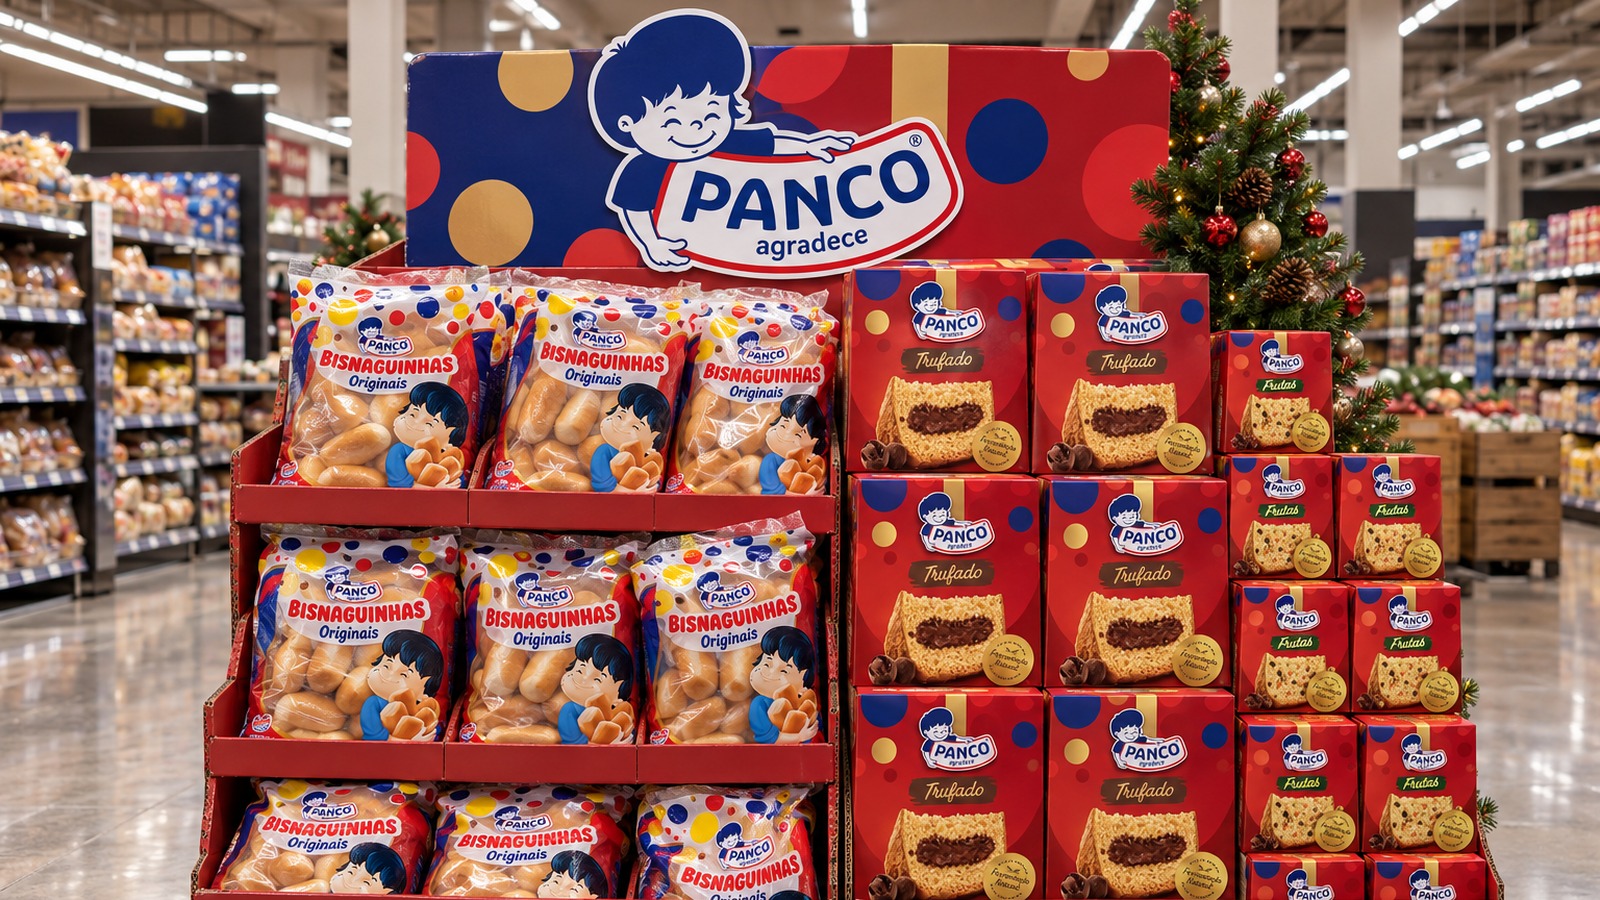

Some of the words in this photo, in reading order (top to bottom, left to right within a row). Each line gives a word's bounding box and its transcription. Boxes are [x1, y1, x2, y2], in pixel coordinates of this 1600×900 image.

[681, 149, 931, 231] PANCO
[756, 229, 868, 261] agradece
[925, 315, 979, 331] PANCO
[1110, 319, 1160, 334] PANCO
[367, 339, 408, 351] PANCO
[582, 332, 621, 345] PANCO
[319, 350, 454, 375] BISNAGUINHAS
[540, 341, 665, 372] BISNAGUINHAS
[746, 349, 785, 361] PANCO
[916, 351, 973, 371] Trufado
[1101, 353, 1156, 373] Trufado
[1269, 358, 1300, 368] PANCO
[565, 367, 622, 387] Originais
[703, 363, 821, 384] BISNAGUINHAS
[348, 375, 407, 392] Originais
[1262, 379, 1297, 391] Frutas
[729, 385, 783, 403] Originais
[1271, 482, 1302, 492] PANCO
[1381, 482, 1412, 492] PANCO
[933, 526, 988, 543] PANCO
[1123, 527, 1177, 545] PANCO
[924, 564, 983, 585] Trufado
[1113, 565, 1171, 586] Trufado
[335, 585, 376, 597] PANCO
[527, 590, 568, 603] PANCO
[711, 587, 750, 604] PANCO
[288, 599, 426, 623] BISNAGUINHAS
[485, 603, 617, 629] BISNAGUINHAS
[669, 594, 798, 633] BISNAGUINHAS
[1284, 614, 1316, 625] PANCO
[1397, 614, 1429, 625] PANCO
[319, 625, 379, 643] Originais
[513, 630, 572, 649] Originais
[700, 628, 758, 650] Originais
[1278, 637, 1313, 649] Frutas
[1390, 637, 1425, 649] Frutas
[934, 742, 989, 759] PANCO
[1125, 743, 1180, 760] PANCO
[1290, 753, 1324, 765] PANCO
[1410, 753, 1443, 765] PANCO
[924, 781, 984, 802] Trufado
[1116, 781, 1174, 802] Trufado
[1283, 777, 1320, 790] Frutas
[1403, 777, 1439, 790] Frutas
[262, 816, 398, 837] BISNAGUINHAS
[505, 818, 547, 831] PANCO
[287, 837, 348, 851] Originais
[457, 827, 593, 848] BISNAGUINHAS
[486, 849, 547, 864] Originais
[729, 841, 770, 861] PANCO
[681, 854, 800, 892] BISNAGUINHAS
[1296, 889, 1329, 900] PANCO
[1418, 889, 1451, 900] PANCO
